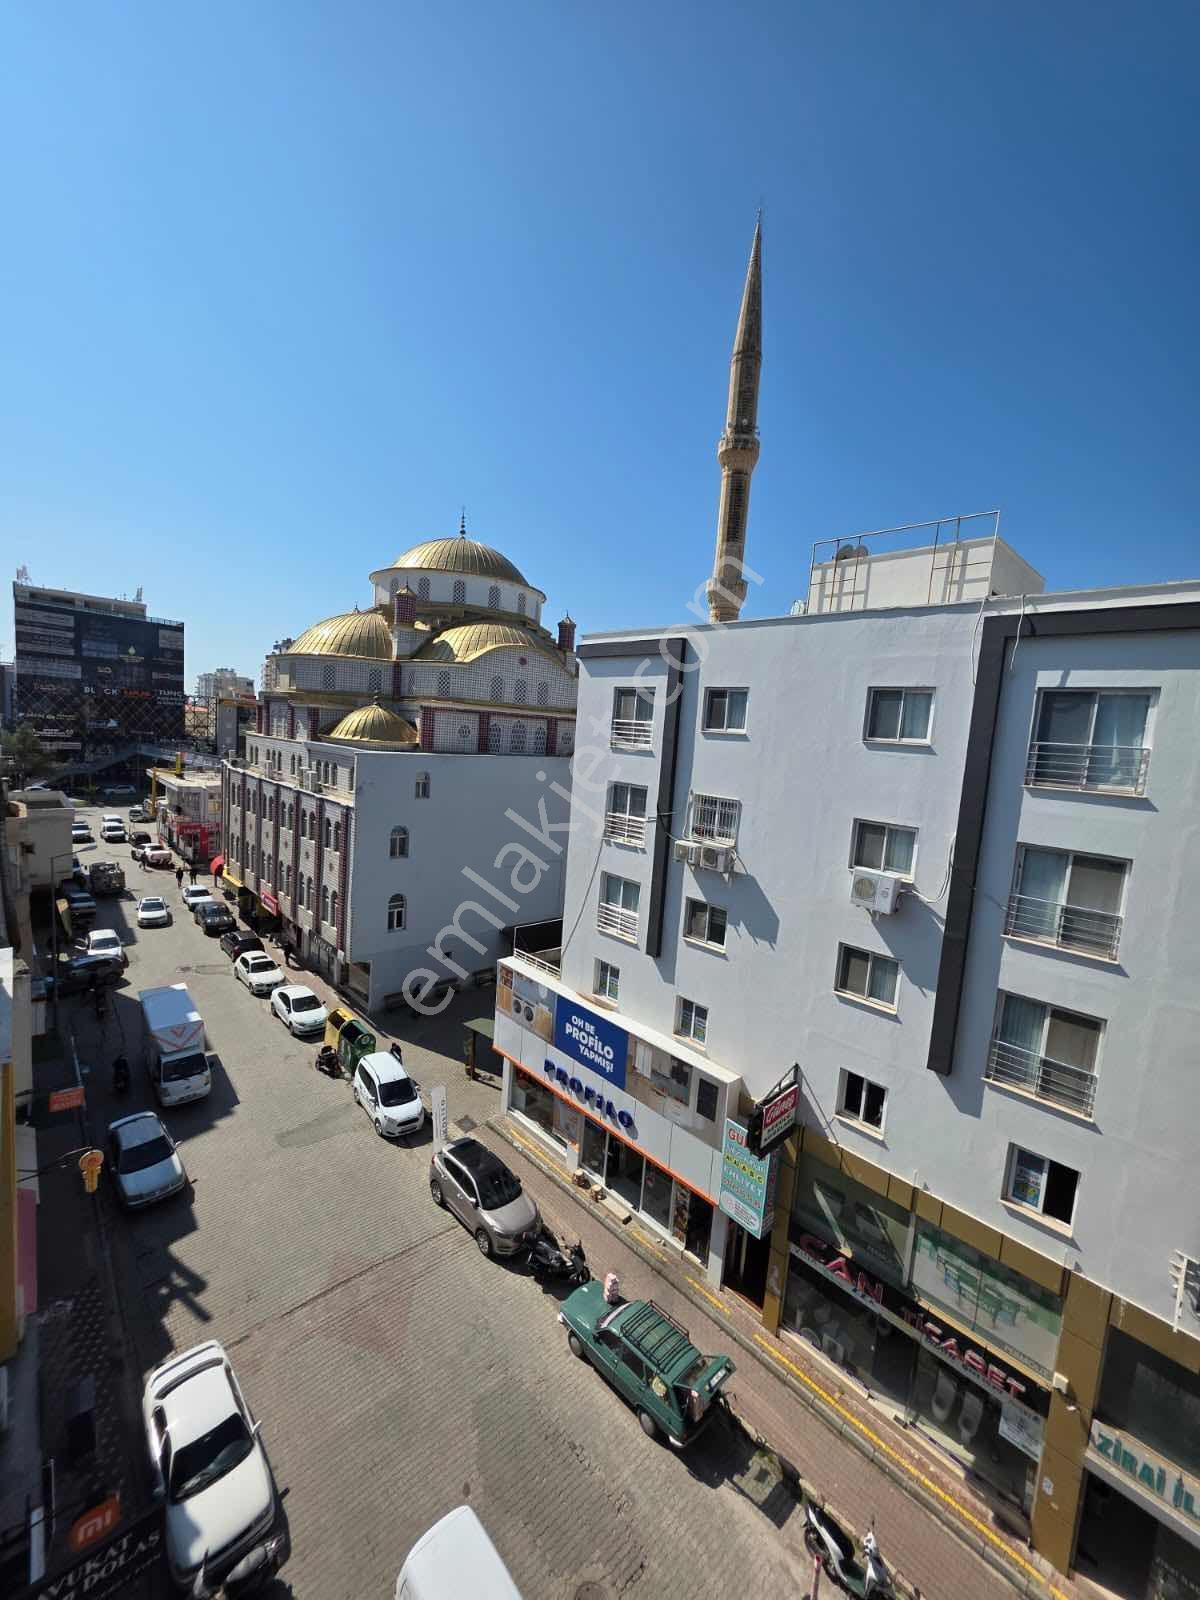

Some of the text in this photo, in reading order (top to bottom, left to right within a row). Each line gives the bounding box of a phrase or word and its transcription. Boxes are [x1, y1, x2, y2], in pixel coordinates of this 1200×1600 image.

[571, 1015, 596, 1035] OH BE
[565, 1021, 614, 1061] PROFİLO
